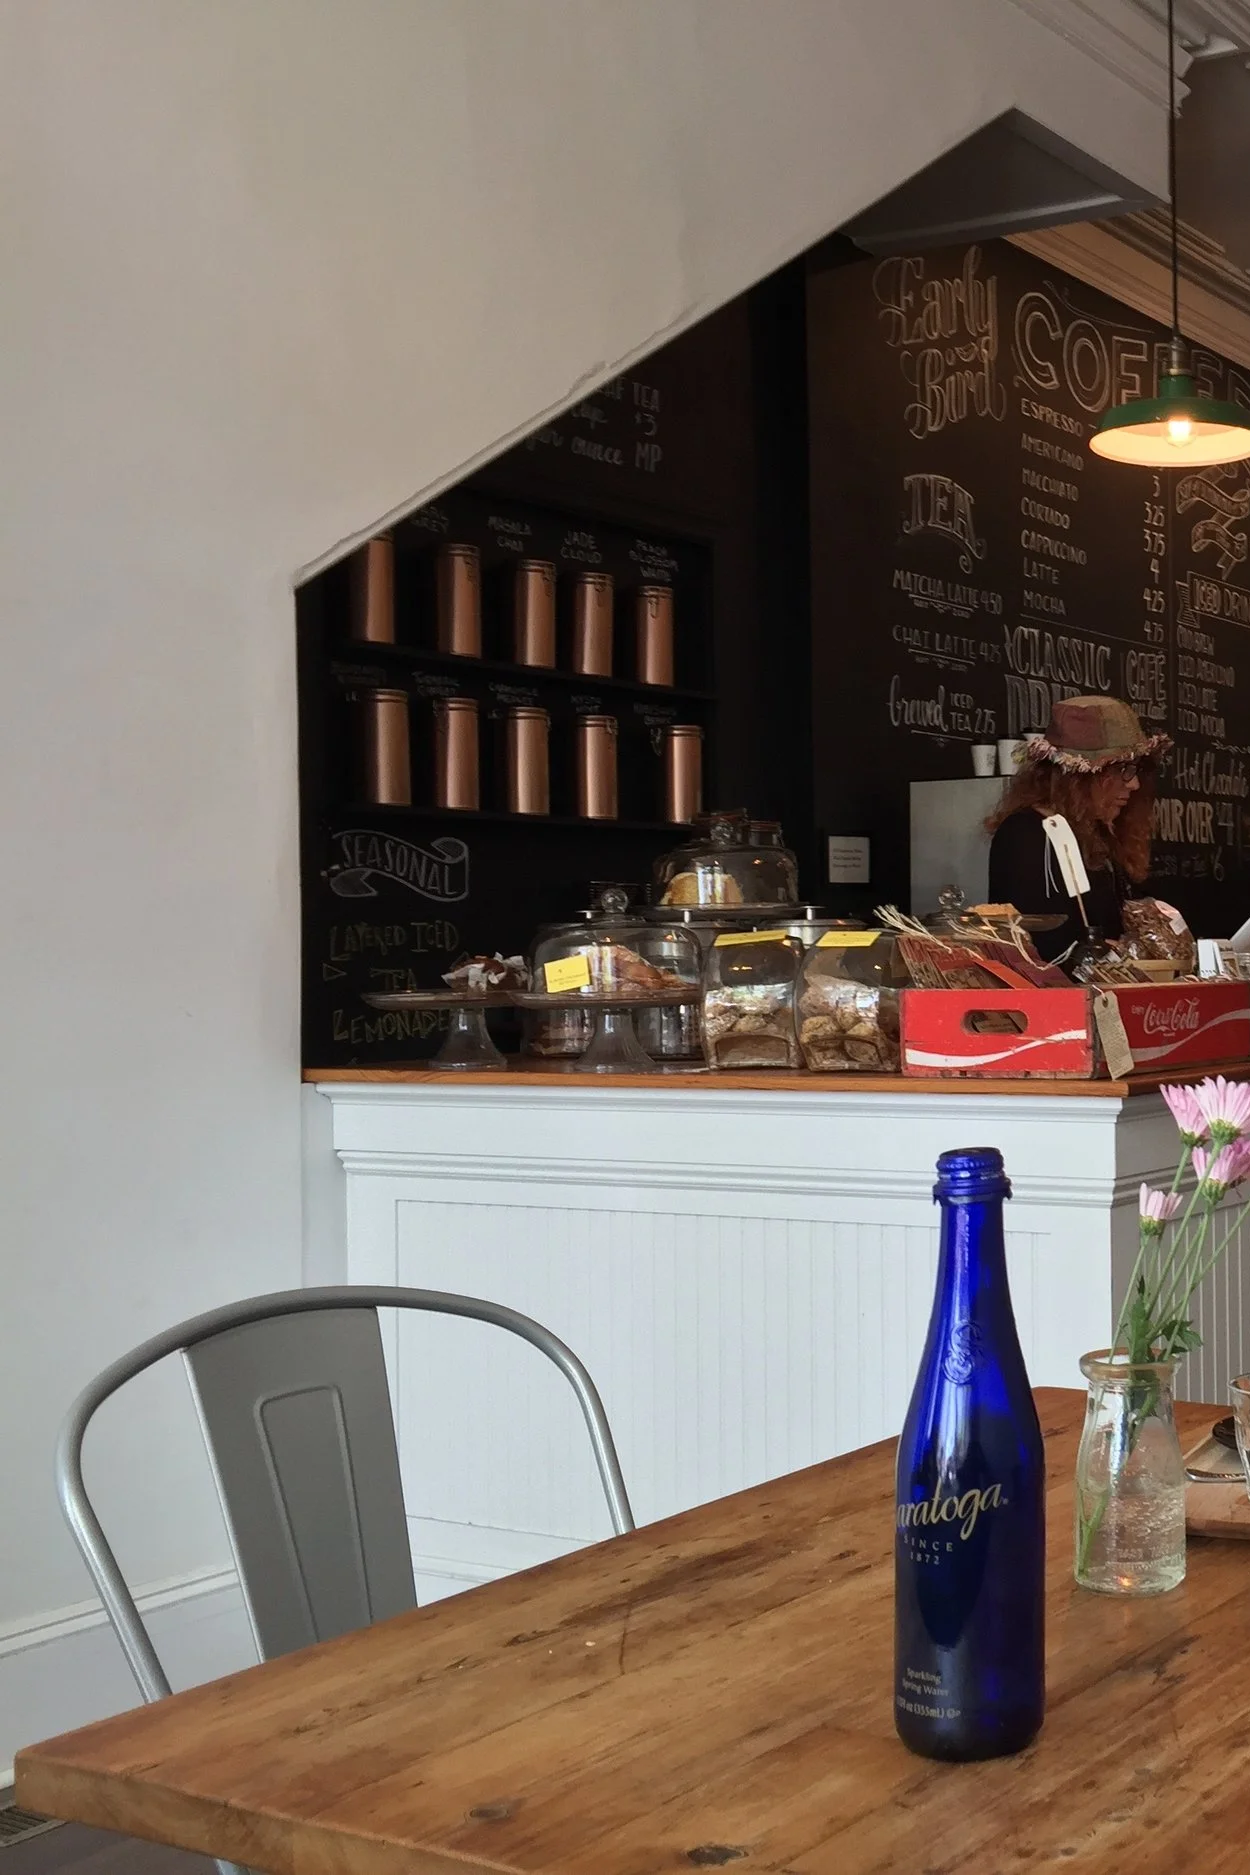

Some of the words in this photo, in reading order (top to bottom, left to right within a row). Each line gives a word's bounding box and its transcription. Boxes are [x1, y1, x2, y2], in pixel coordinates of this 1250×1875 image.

[872, 245, 999, 362] Early
[632, 381, 661, 412] TEA
[900, 349, 1007, 440] Bird
[1020, 398, 1084, 437] ESPRESSO
[635, 441, 664, 473] MP
[1021, 432, 1085, 471] AMERICANO
[1021, 467, 1080, 502] MACCHIATO
[903, 473, 988, 560] TEA
[1020, 496, 1071, 530] CORTADO
[1020, 529, 1088, 566] CAPPUCCINO
[1150, 557, 1161, 584] 4
[1023, 556, 1061, 585] LATTE
[892, 568, 945, 598] MATCHA
[947, 582, 980, 609] LATTE
[1023, 588, 1068, 616] MOCHA
[892, 624, 932, 650] CHAI
[935, 632, 978, 660] LATTE
[1012, 625, 1112, 692] CLASSIC
[949, 691, 975, 710] ICED
[949, 711, 973, 733] TEA
[1174, 747, 1200, 793] Hot
[1151, 797, 1185, 843] POUR
[1185, 800, 1216, 845] OVER
[339, 834, 460, 897] SEASONAL
[896, 1475, 1004, 1542] aratoga
[903, 1533, 954, 1553] SINCE
[910, 1551, 941, 1566] 1872
